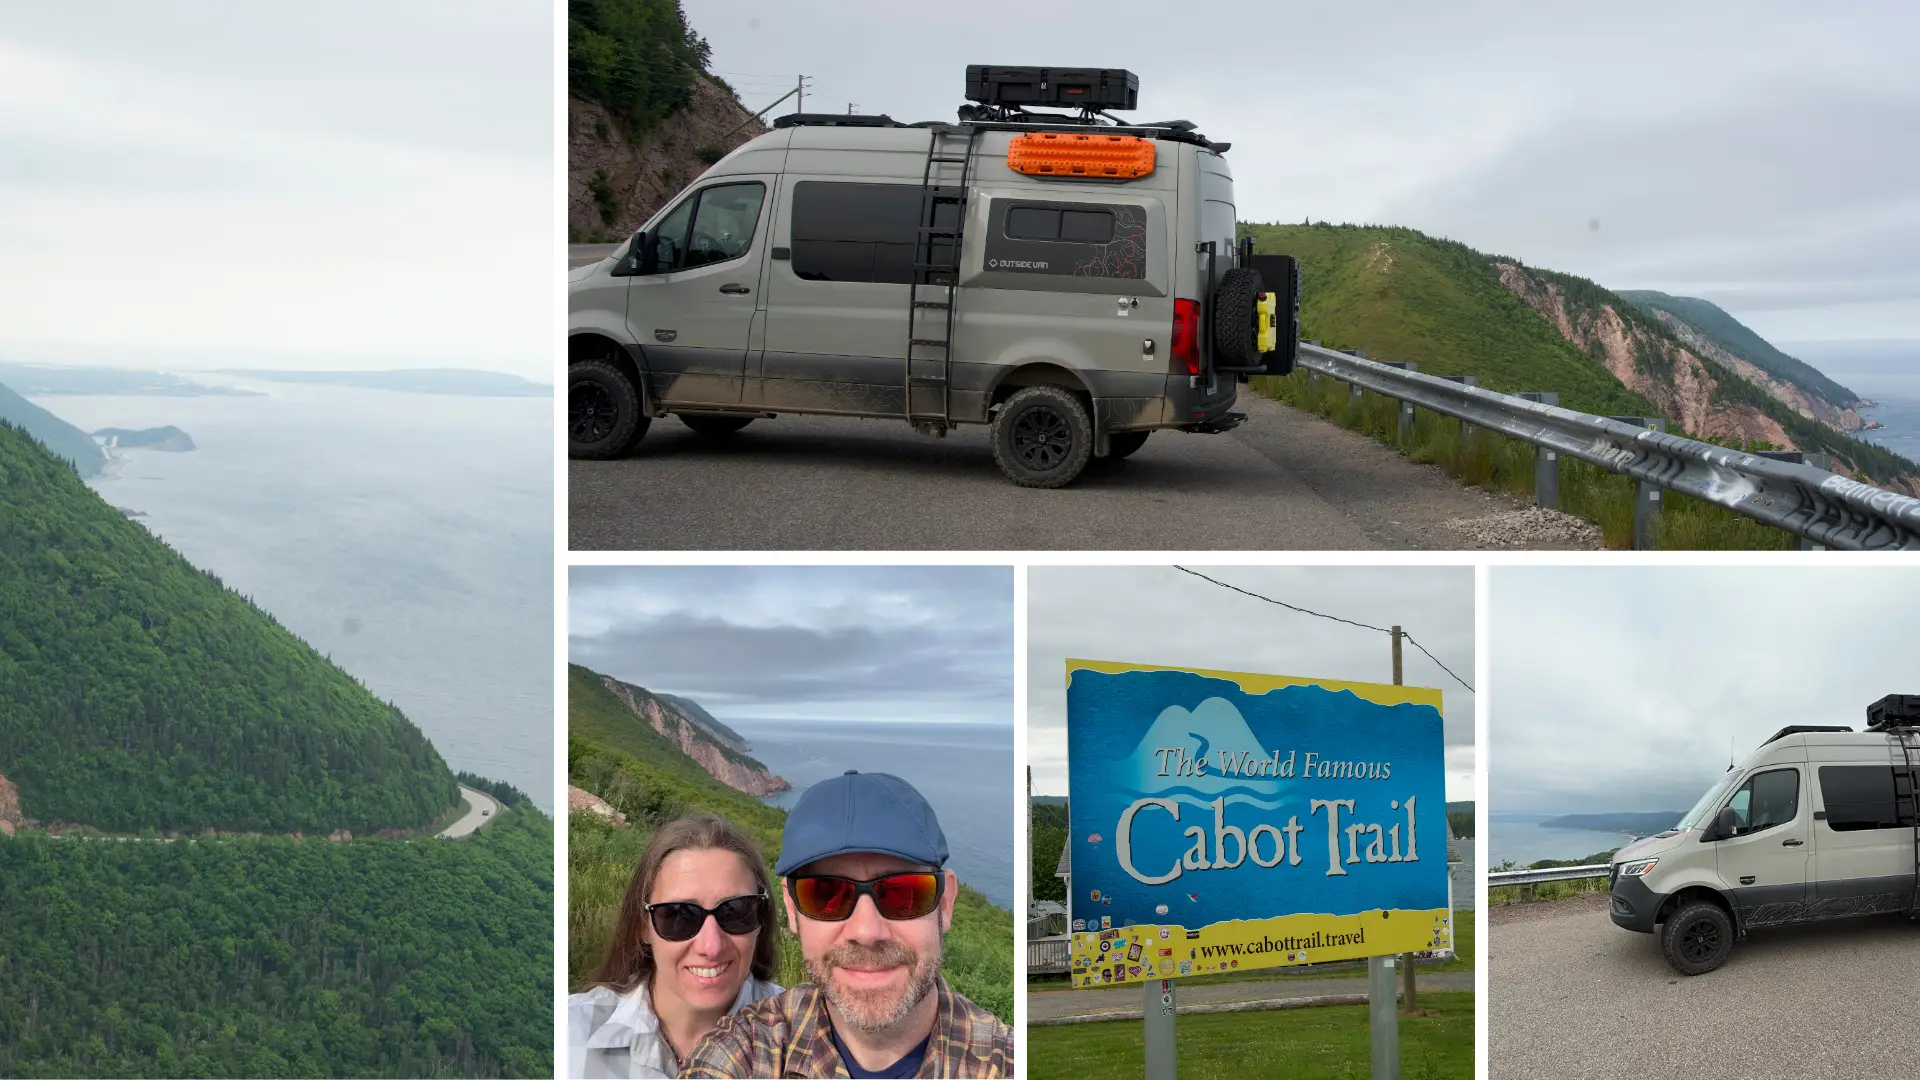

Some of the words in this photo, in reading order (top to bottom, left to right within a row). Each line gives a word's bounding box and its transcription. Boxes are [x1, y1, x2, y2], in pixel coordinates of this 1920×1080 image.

[1000, 260, 1032, 269] OUTSIDE
[1032, 261, 1049, 269] VAN
[1155, 747, 1209, 778] The
[1217, 749, 1296, 779] World
[1302, 752, 1392, 780] Famous
[1115, 795, 1304, 885] Cabot
[1310, 795, 1420, 877] Trail
[1200, 928, 1365, 959] www.cabottrail.travel
